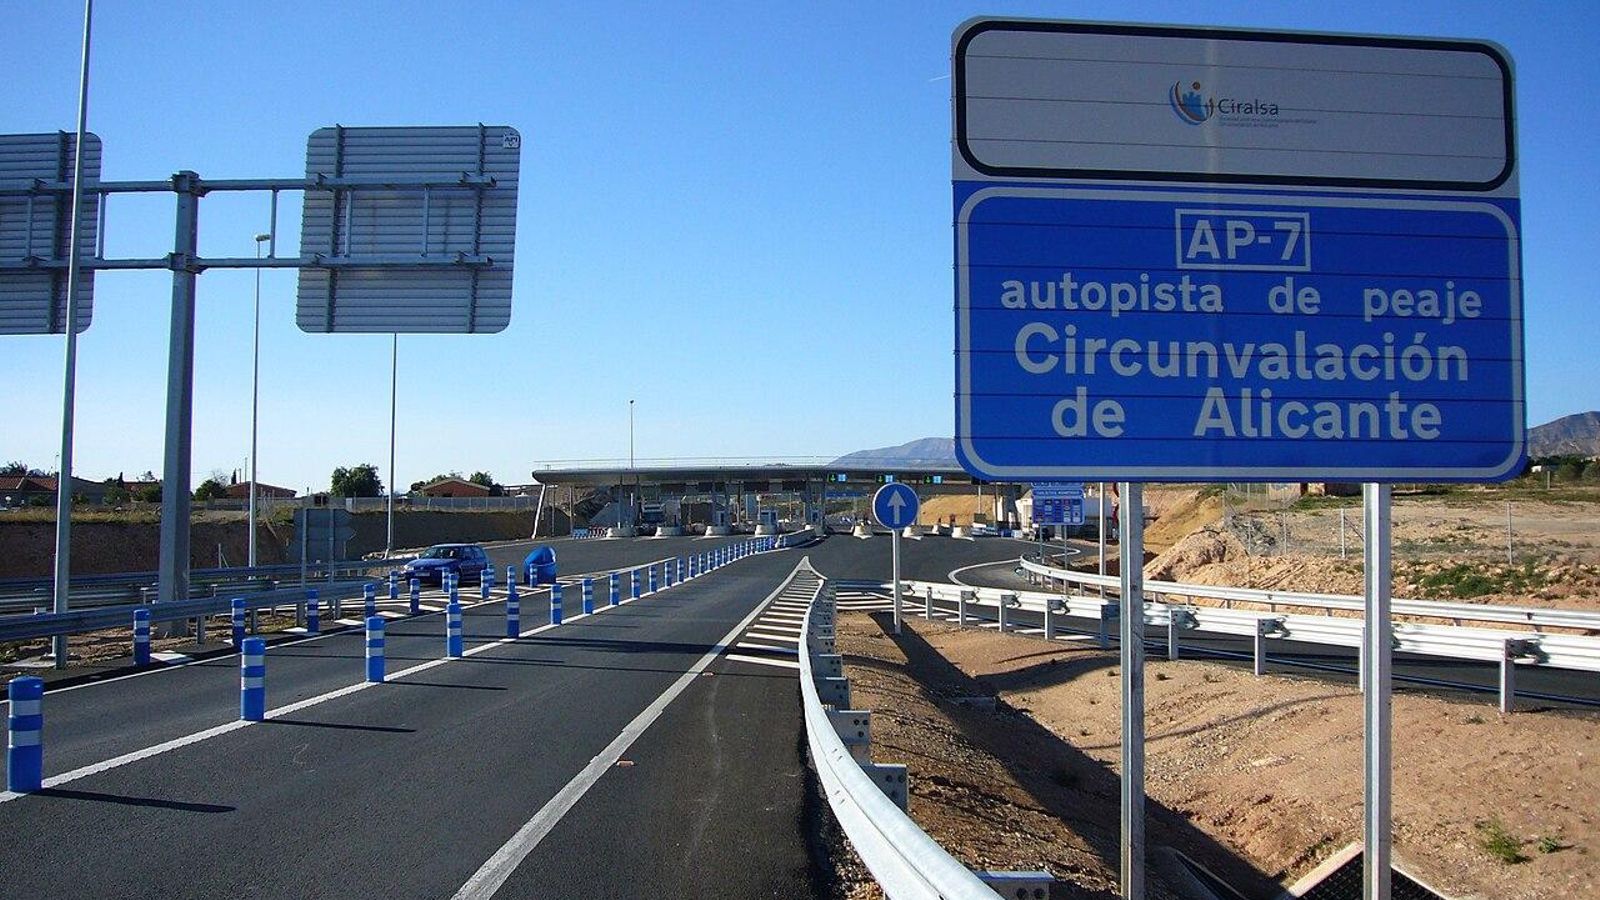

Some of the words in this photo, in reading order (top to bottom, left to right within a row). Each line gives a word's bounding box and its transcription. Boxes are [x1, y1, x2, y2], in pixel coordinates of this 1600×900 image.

[1218, 99, 1278, 116] Ciralsa
[1186, 219, 1301, 261] AP-7
[1001, 272, 1223, 317] autopista
[1268, 276, 1321, 314] de
[1364, 281, 1482, 325] peaje
[1015, 322, 1468, 381] Circunvalación
[1052, 386, 1125, 438] de
[1193, 387, 1442, 440] Alicante
